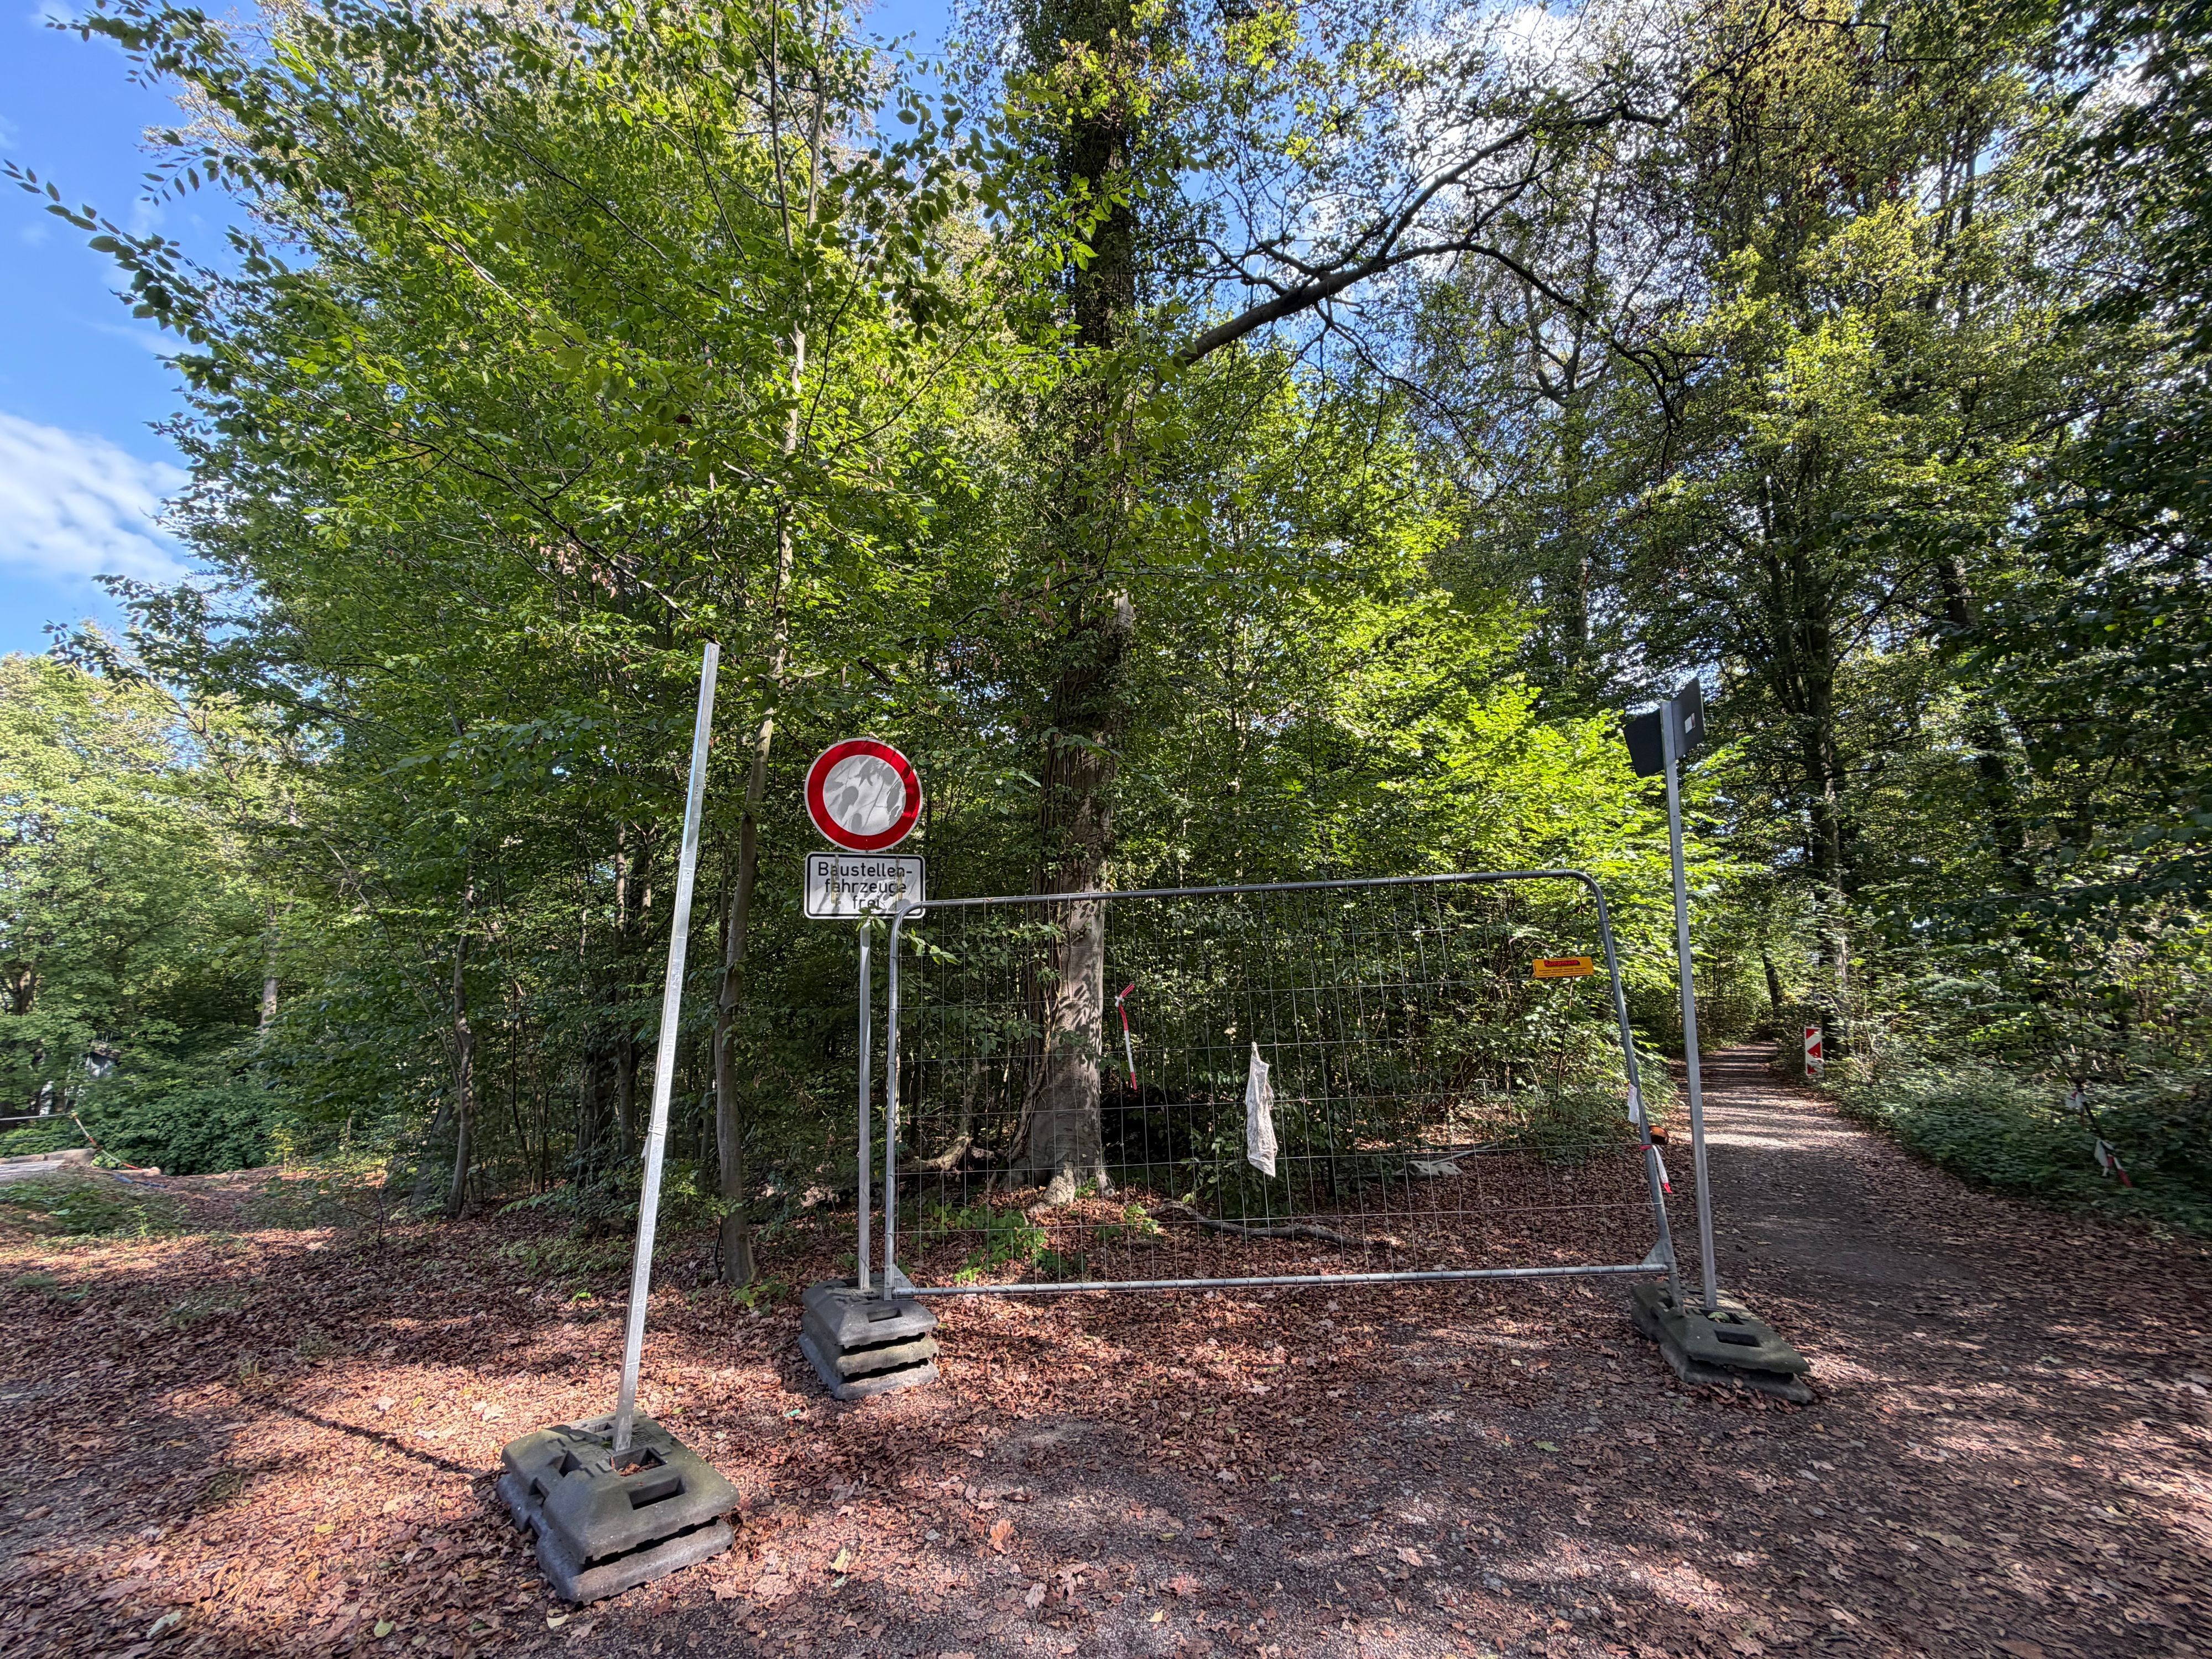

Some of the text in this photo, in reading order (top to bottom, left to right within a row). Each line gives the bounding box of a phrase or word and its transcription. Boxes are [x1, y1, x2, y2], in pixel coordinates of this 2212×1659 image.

[818, 862, 912, 877] Baustellen-
[825, 878, 906, 896] fahrzeuge
[852, 895, 880, 909] frei
